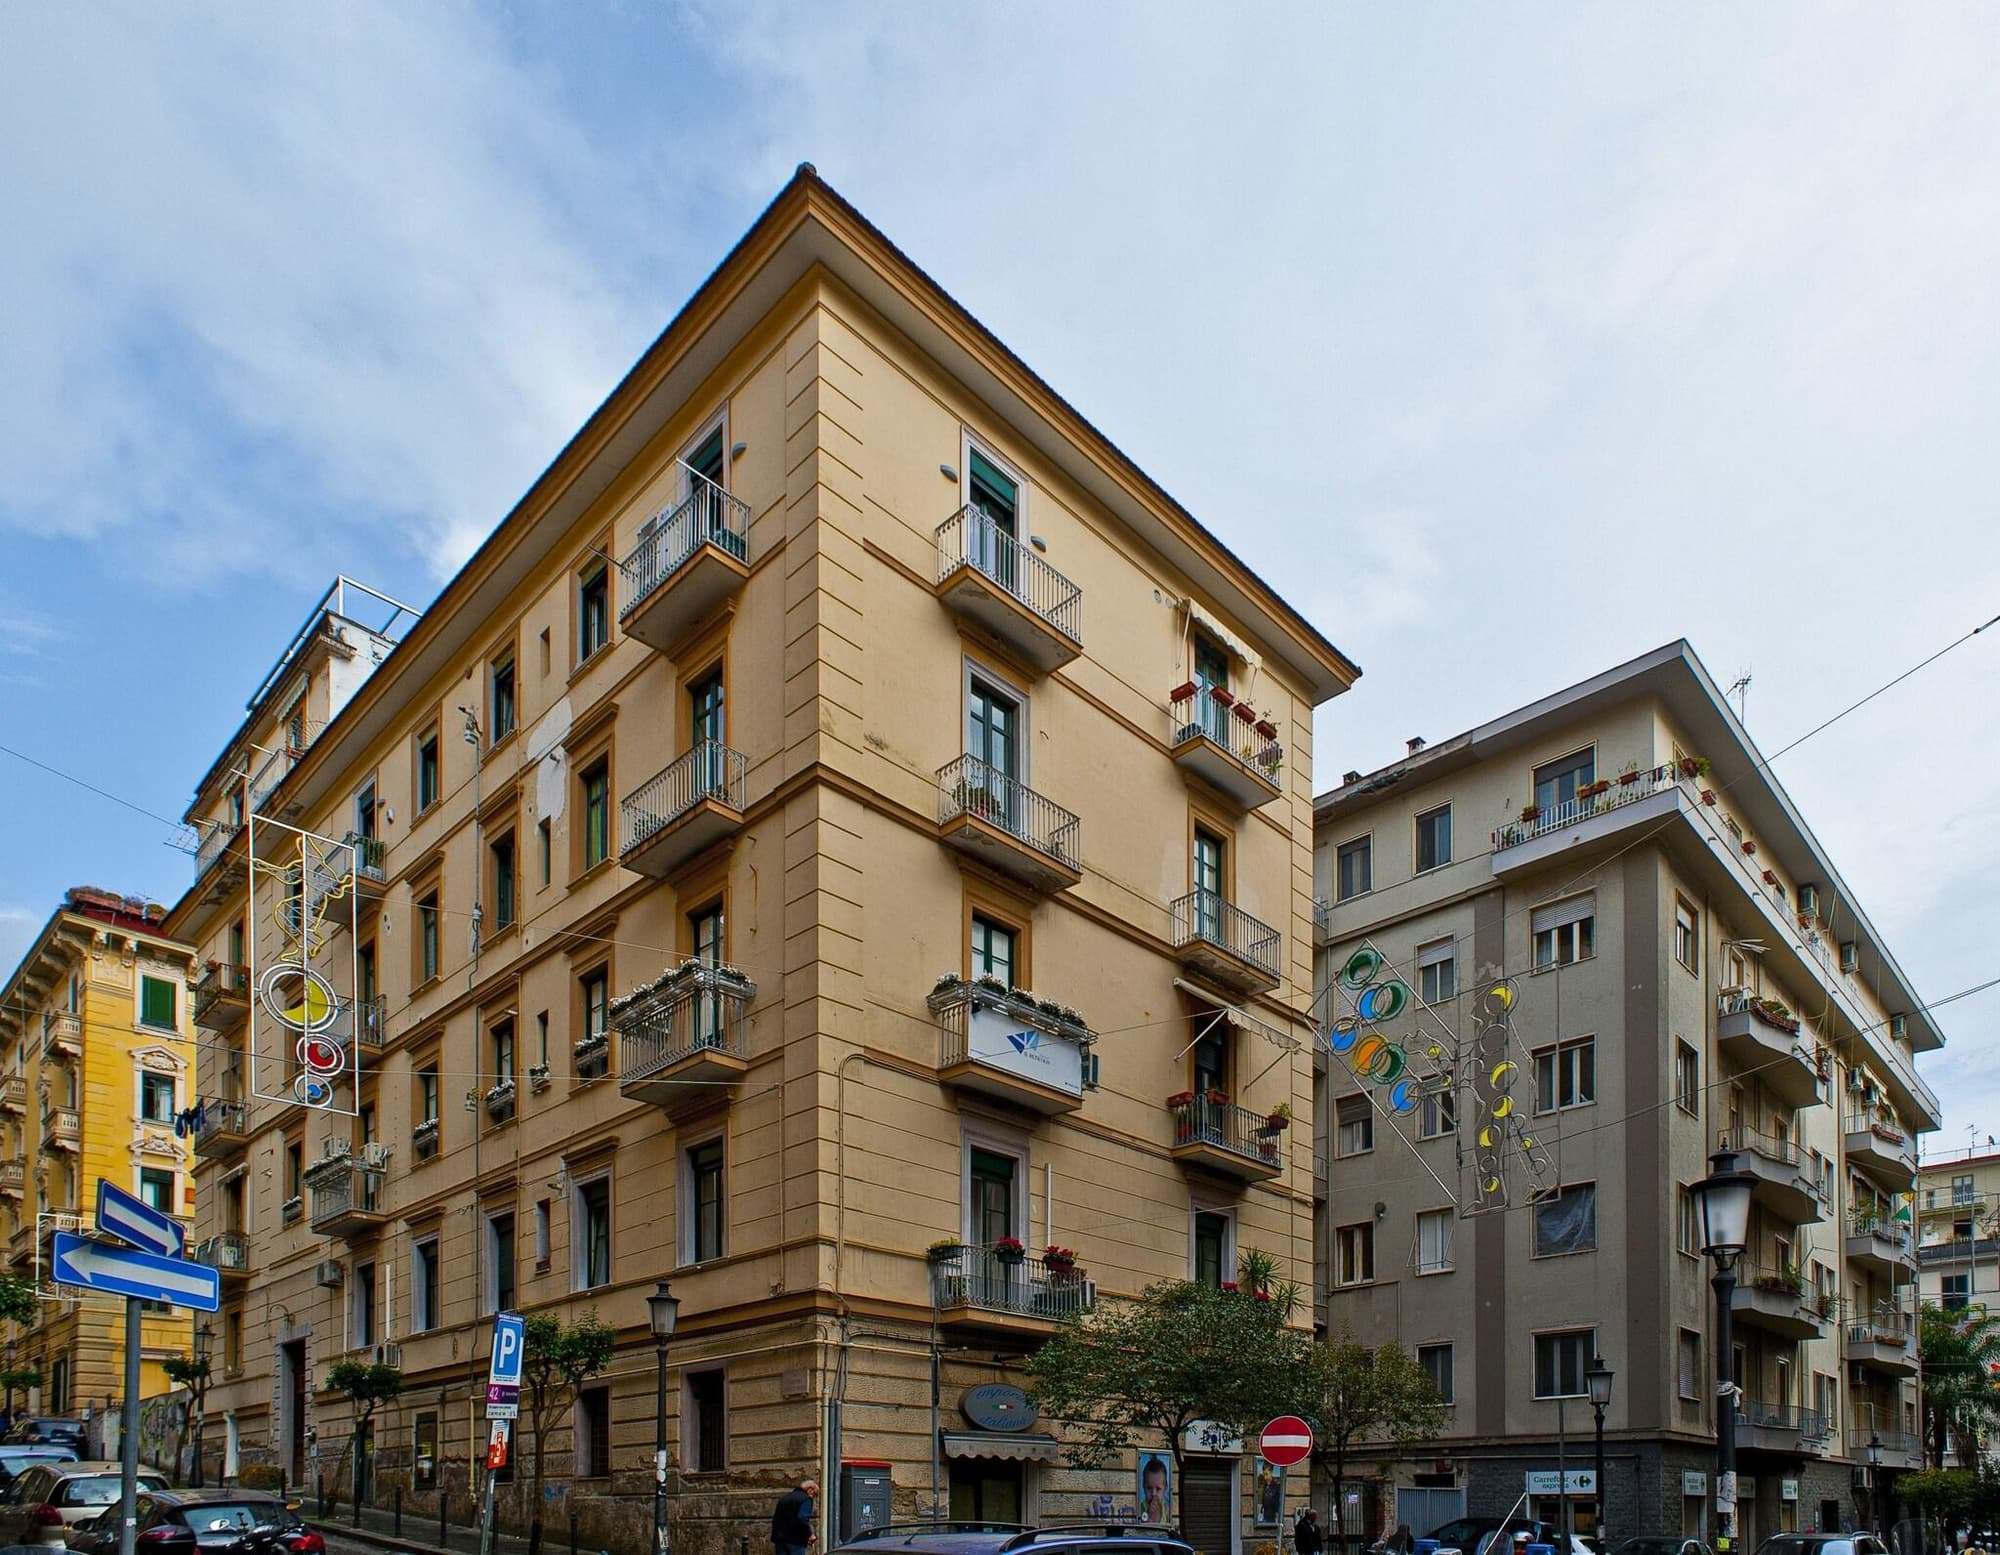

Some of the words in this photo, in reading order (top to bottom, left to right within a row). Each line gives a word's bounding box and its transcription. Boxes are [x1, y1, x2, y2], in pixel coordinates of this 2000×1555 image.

[499, 1327, 516, 1368] P
[489, 1386, 499, 1400] 42
[1534, 1475, 1570, 1483] Carrefor
